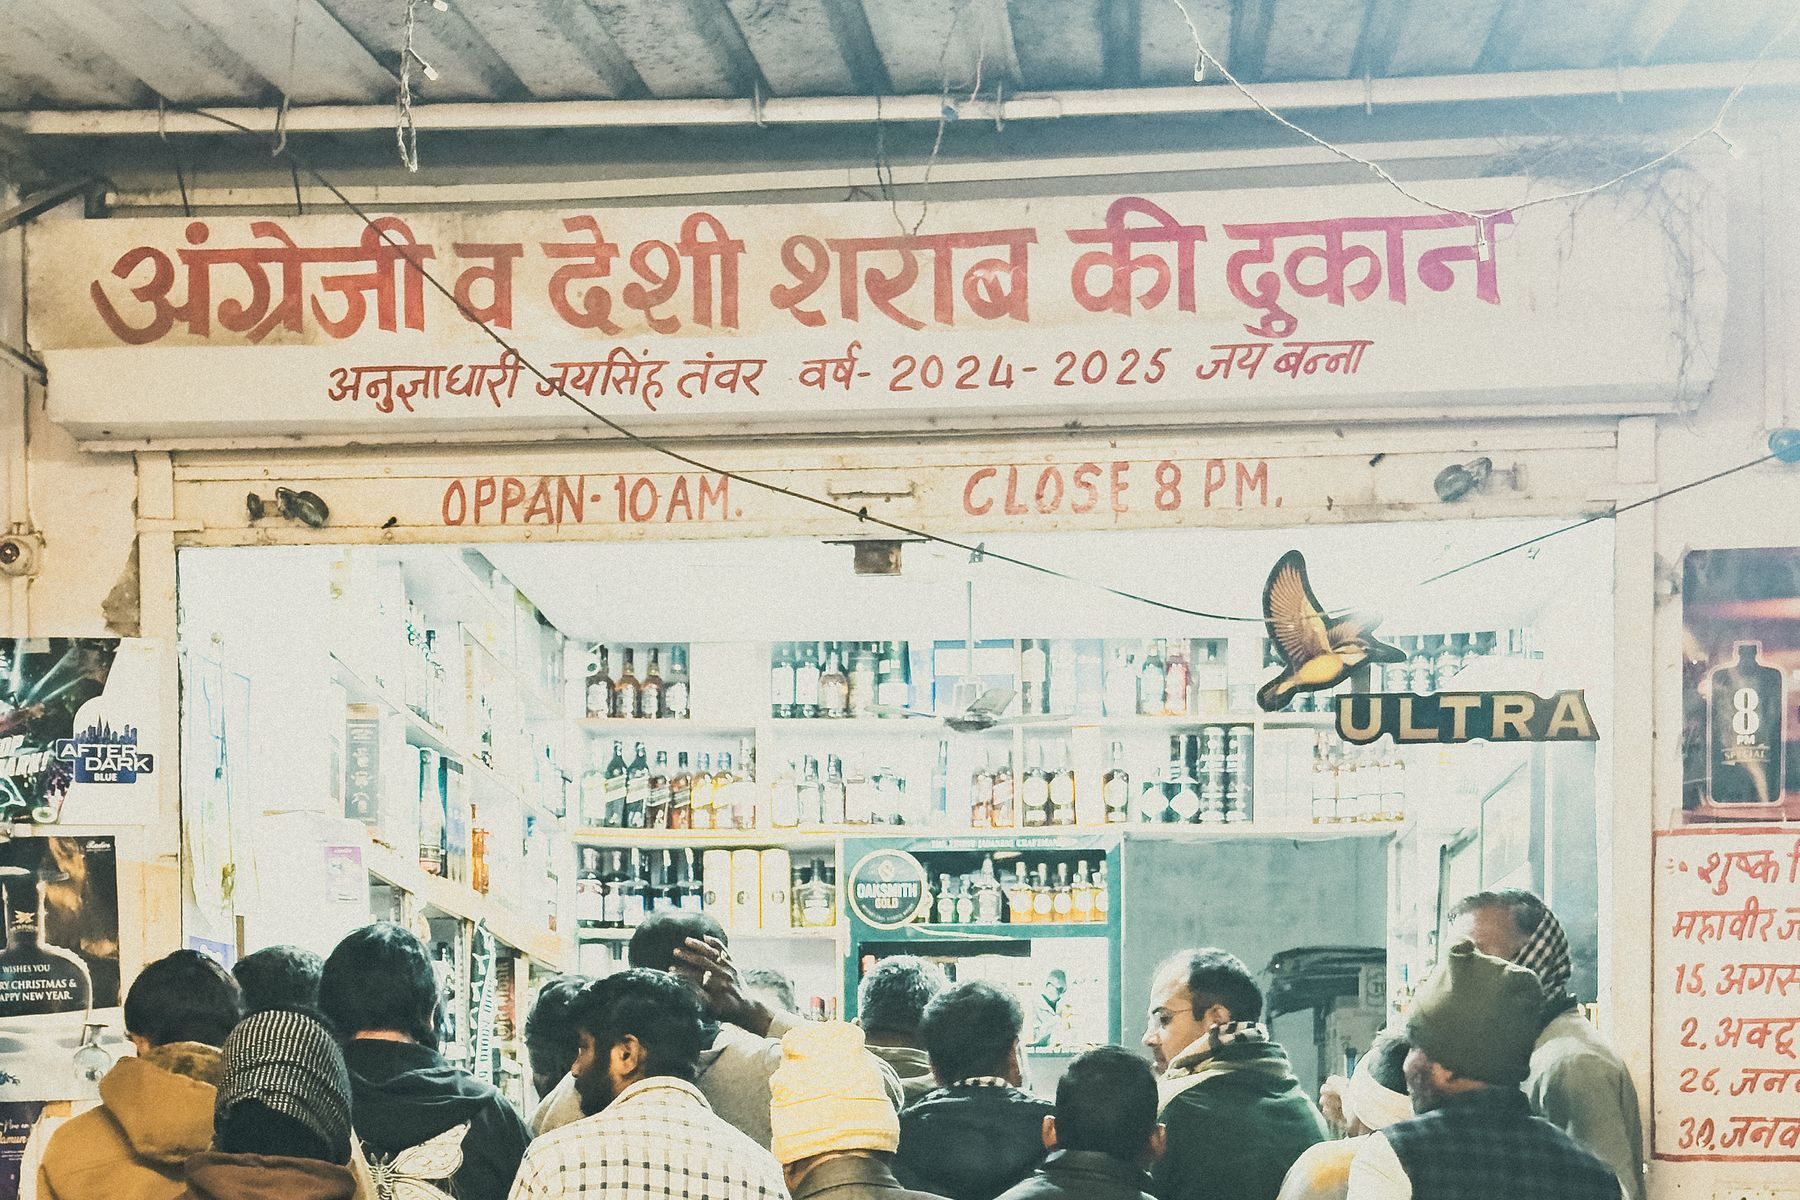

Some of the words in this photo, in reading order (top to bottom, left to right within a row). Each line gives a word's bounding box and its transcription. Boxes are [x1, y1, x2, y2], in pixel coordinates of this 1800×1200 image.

[90, 216, 434, 346] अंग्रेजी
[453, 242, 524, 332] व
[541, 211, 746, 336] देशी
[769, 227, 1037, 331] शराब
[1067, 196, 1208, 317] की
[1223, 209, 1514, 338] दुकान
[535, 346, 670, 412] जयसिंह
[677, 351, 768, 398] तंवर
[798, 340, 872, 391] वर्ष-
[1054, 347, 1172, 387] 2025
[1195, 342, 1275, 381] जय
[963, 460, 1130, 516] CLOSE
[1155, 459, 1183, 512] 8
[1340, 693, 1593, 741] ULTRA
[1732, 687, 1760, 735] 8
[60, 743, 137, 758] AFTER
[1736, 733, 1756, 746] PM
[85, 757, 150, 772] DARK
[94, 772, 118, 782] BLUE
[1672, 895, 1777, 944] महावीर
[2, 965, 32, 973] WISHES
[33, 964, 51, 972] YOU
[11, 979, 67, 990] CHRISTMAS
[68, 978, 77, 988] &
[22, 992, 44, 1001] NEW
[45, 990, 74, 1001] YEAR.
[1680, 1017, 1707, 1050] 2.
[1679, 1067, 1720, 1096] 26.
